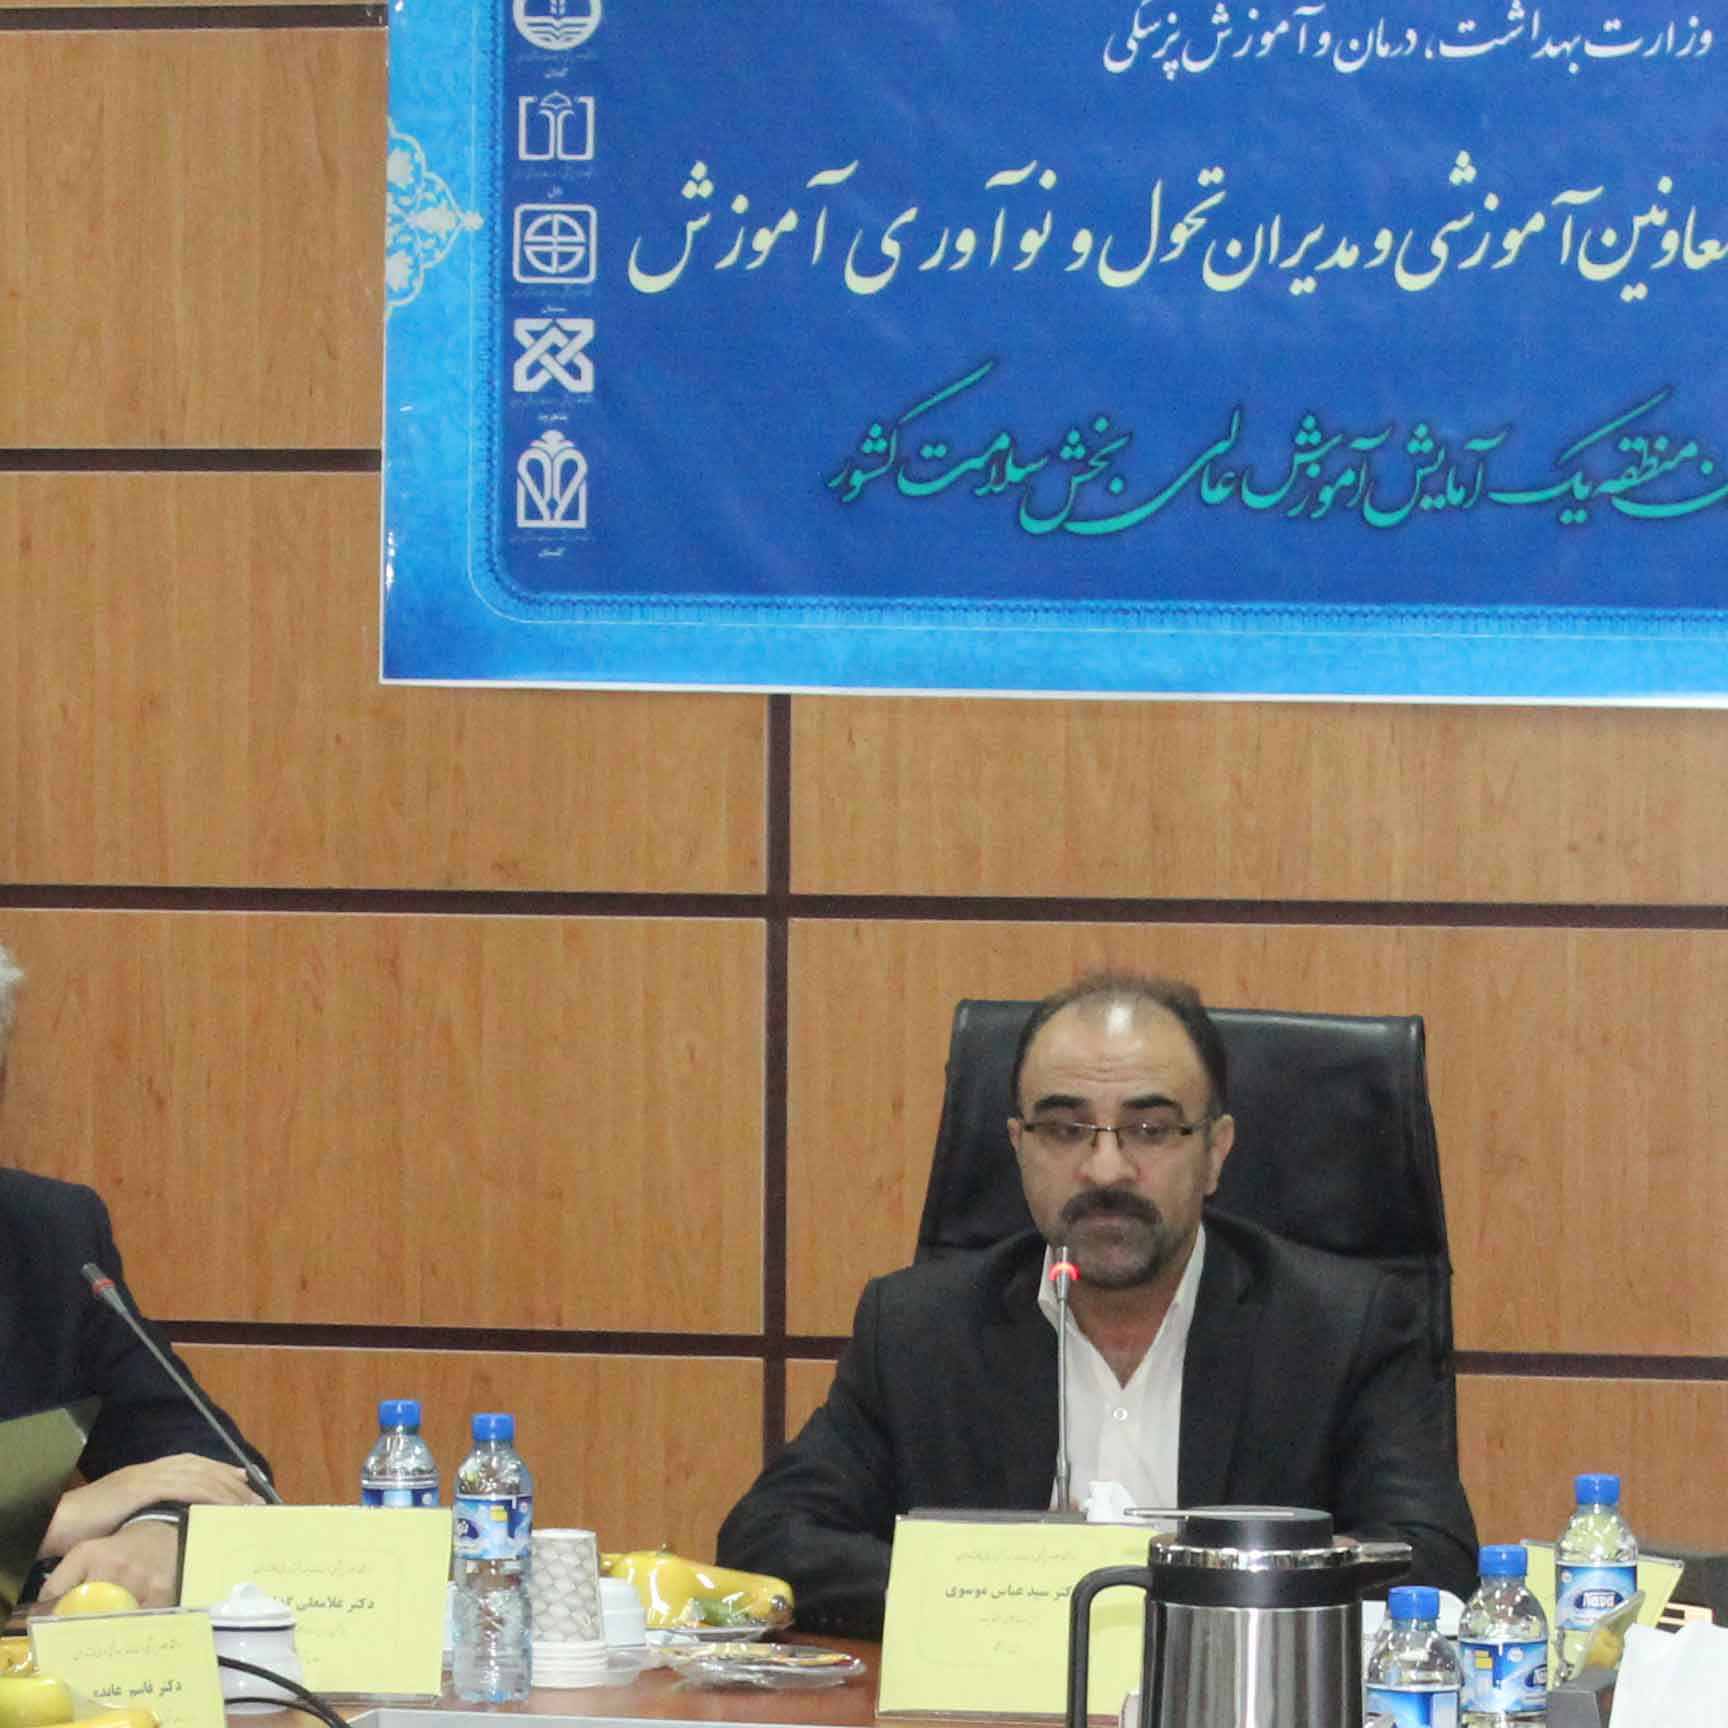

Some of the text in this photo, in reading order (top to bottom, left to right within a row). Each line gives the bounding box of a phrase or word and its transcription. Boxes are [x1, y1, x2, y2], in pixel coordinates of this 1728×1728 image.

[1102, 2, 1181, 81] پزشکی
[1180, 2, 1327, 74] آموزش
[1313, 25, 1332, 59] و
[1333, 17, 1418, 74] درمان
[1586, 15, 1713, 58] وزارت
[627, 158, 862, 295] آموزش
[843, 158, 1060, 295] نوآوری
[1064, 227, 1094, 272] و
[1097, 165, 1229, 289] تحول
[1201, 213, 1362, 297] مدیران
[1364, 226, 1393, 271] و
[1393, 149, 1606, 293] آموزشی
[827, 358, 995, 503] کشور
[896, 429, 1051, 498] سلامت
[1239, 412, 1394, 519] آموزش
[1591, 433, 1701, 500] منطقه
[1018, 415, 1134, 536] بخش
[1363, 422, 1514, 529] آمایش
[944, 1585, 988, 1599] موسوی
[1052, 1584, 1073, 1601] کتر
